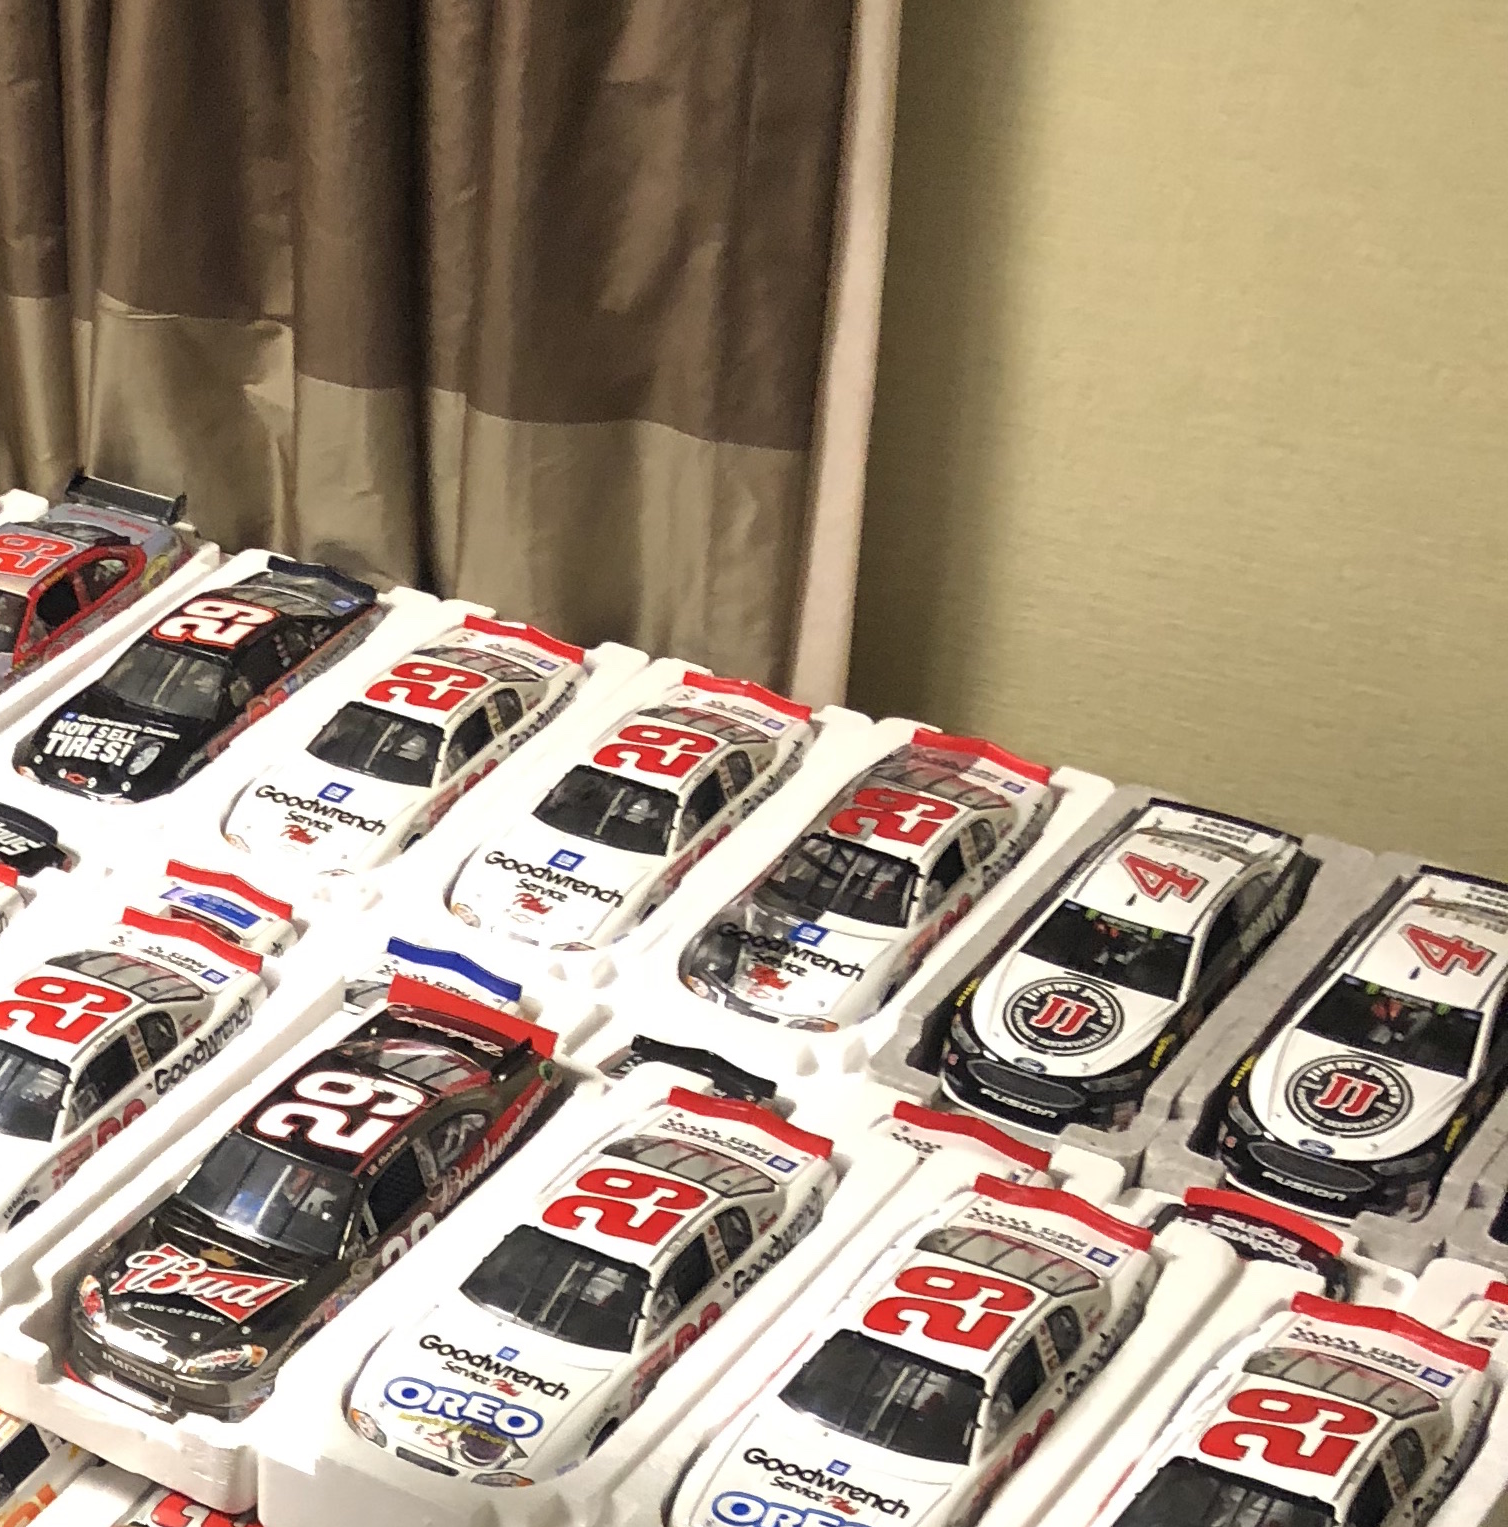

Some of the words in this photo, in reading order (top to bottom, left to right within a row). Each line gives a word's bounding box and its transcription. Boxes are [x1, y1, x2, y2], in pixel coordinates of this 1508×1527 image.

[152, 600, 280, 649] 29
[365, 662, 488, 711] 29
[43, 732, 132, 767] TIRES!
[52, 720, 96, 737] NOW
[95, 725, 138, 745] SELL
[593, 724, 717, 778] 29
[255, 784, 387, 836] Goodwrench
[284, 811, 334, 833] Service
[827, 787, 960, 846] 29
[485, 851, 626, 908] Goodwrench
[515, 878, 567, 903] Service
[1120, 852, 1209, 903] 4
[718, 923, 866, 982] Goodwrench
[1398, 923, 1497, 976] 4
[1029, 994, 1098, 1036] JJ
[153, 998, 253, 1095] Goodwrench
[255, 1071, 426, 1158] 29
[979, 1087, 1058, 1119] FUSION
[1313, 1072, 1384, 1116] JJ
[542, 1168, 707, 1245] 29
[1262, 1171, 1347, 1202] FUSION
[125, 1251, 287, 1308] Bud
[134, 1302, 165, 1313] KING
[165, 1307, 181, 1315] OF
[863, 1266, 1035, 1351] 29
[419, 1334, 569, 1400] Goodwrench
[442, 1361, 490, 1385] Service
[491, 1376, 522, 1397] Plus
[384, 1376, 543, 1438] OREO
[1199, 1388, 1378, 1476] 29
[743, 1448, 910, 1519] Goodwrench
[770, 1475, 824, 1503] Service
[826, 1494, 860, 1516] Plus
